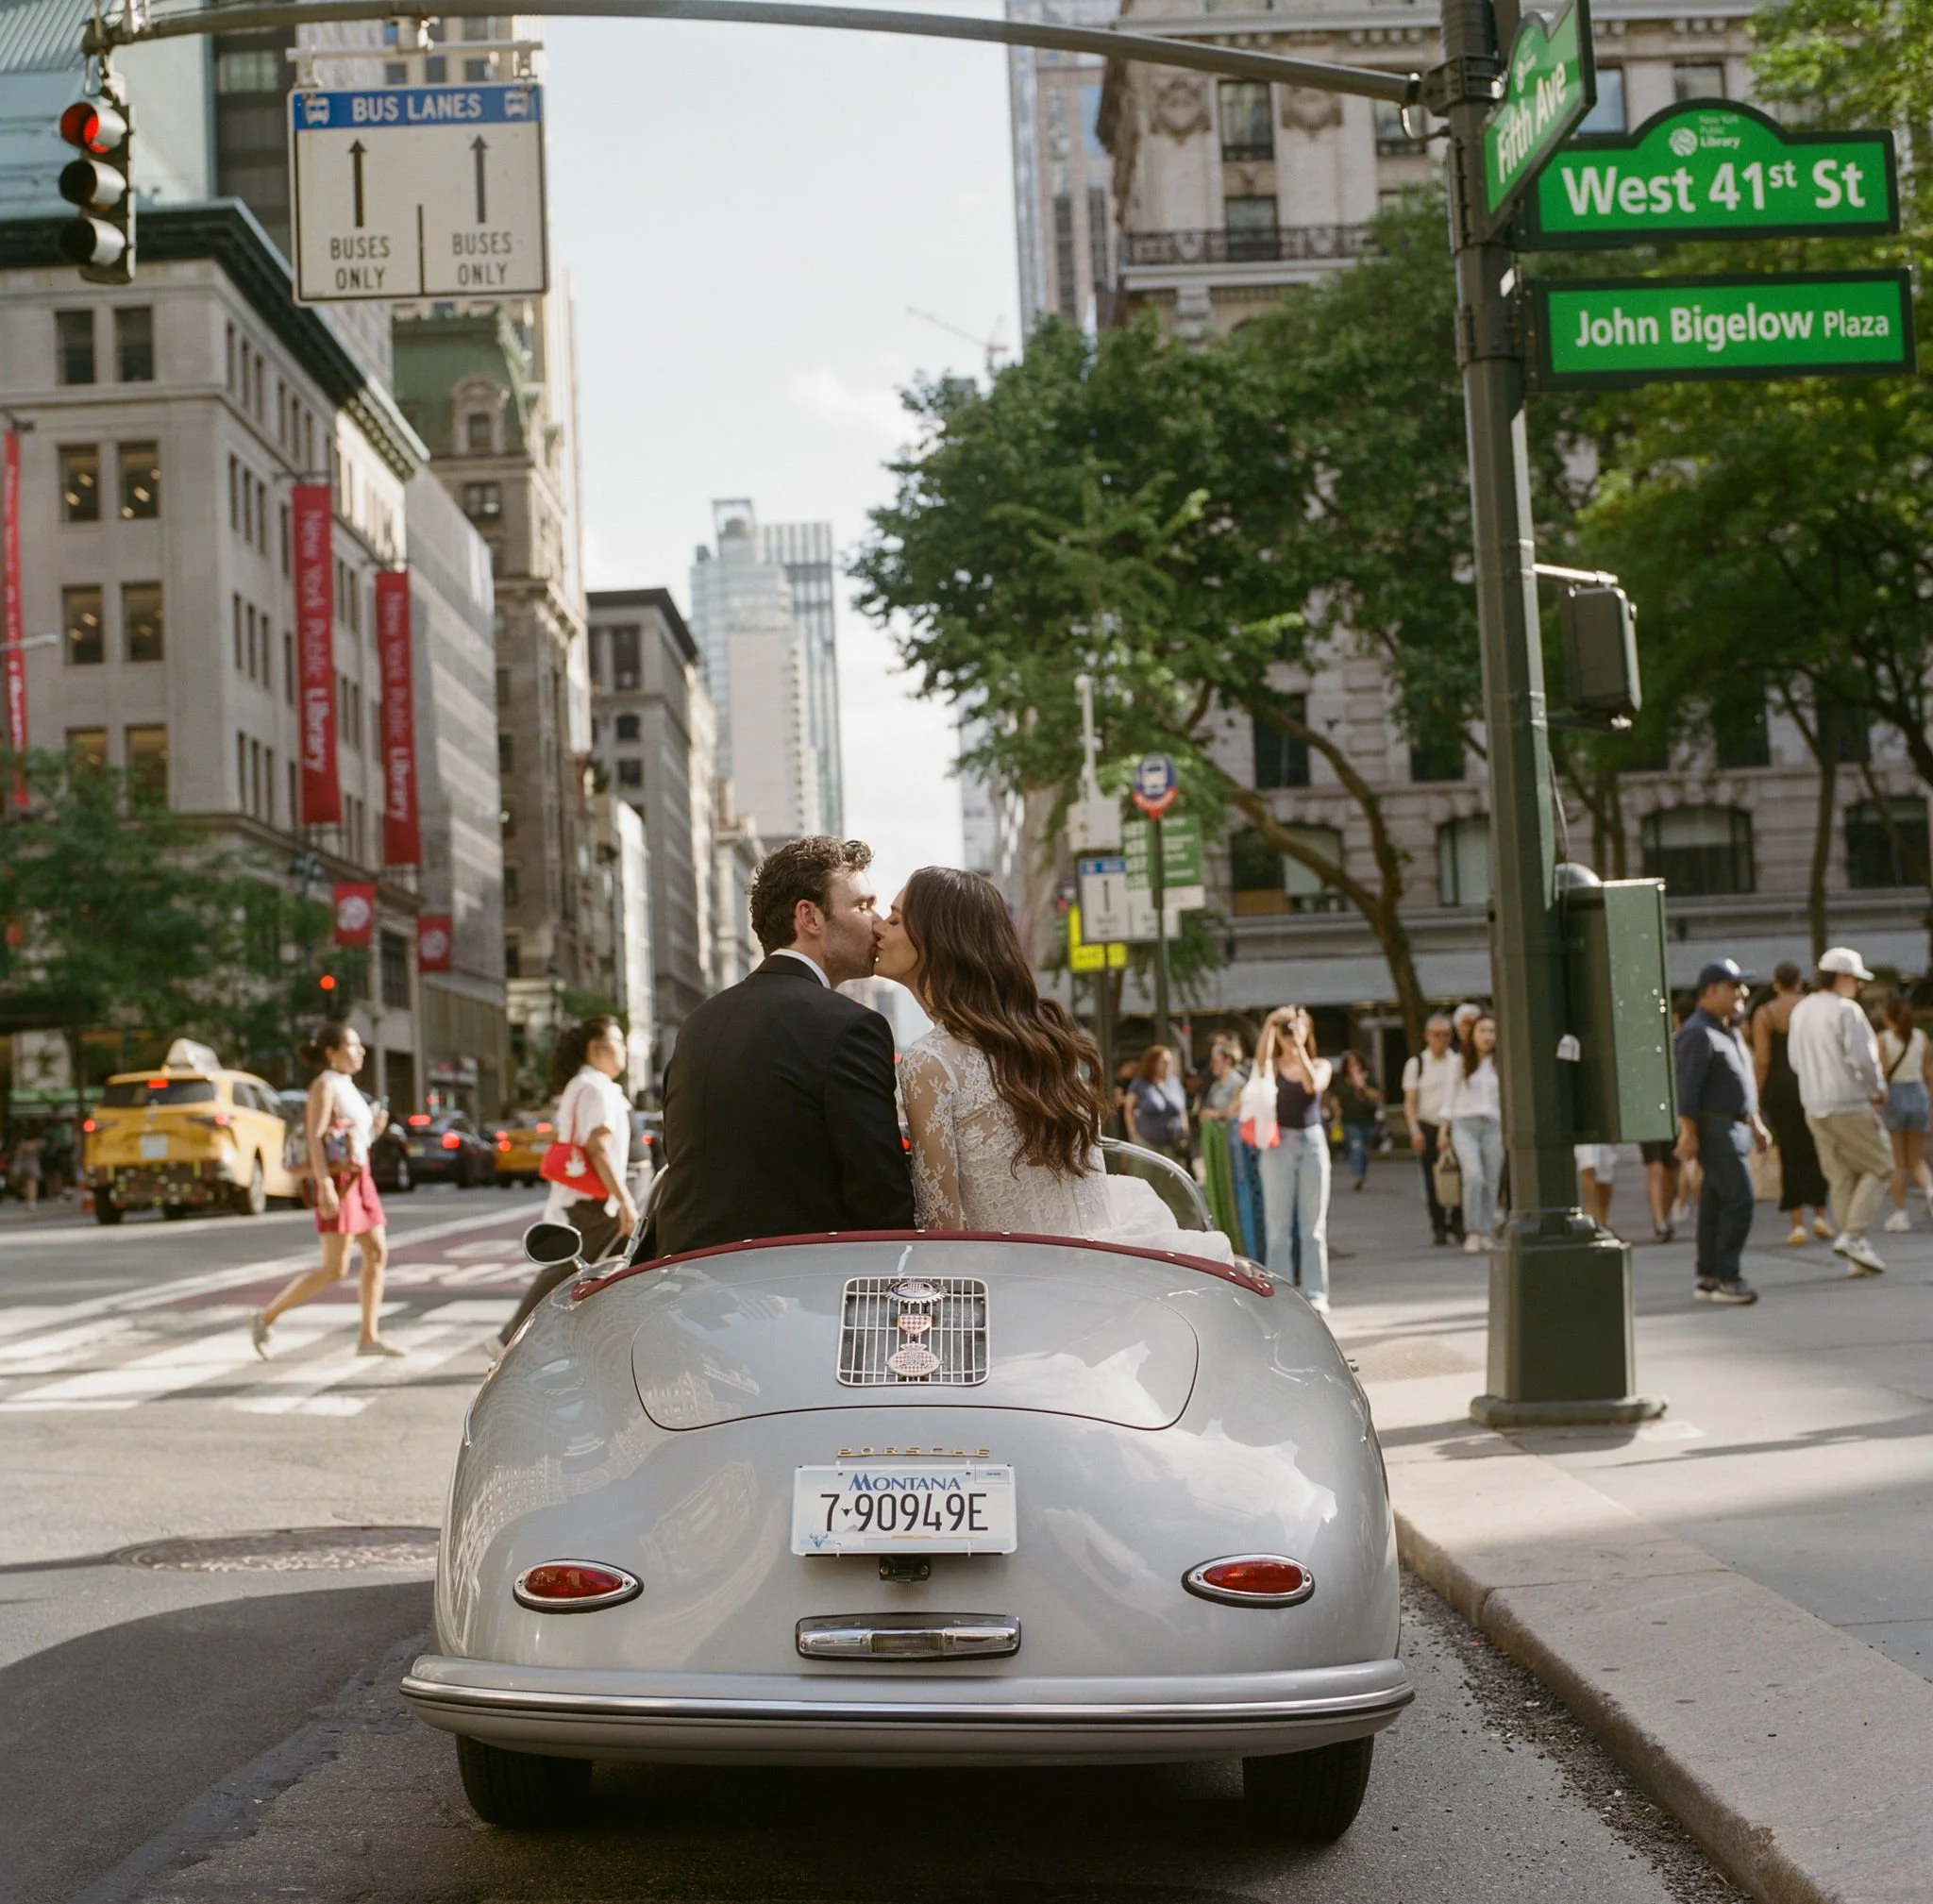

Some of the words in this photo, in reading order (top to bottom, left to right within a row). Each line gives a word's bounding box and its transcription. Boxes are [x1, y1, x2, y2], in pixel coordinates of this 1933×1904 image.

[351, 94, 399, 123] BUS
[407, 93, 483, 120] LANES
[1497, 98, 1533, 183] Fifth
[1536, 61, 1567, 135] Ave
[1700, 136, 1740, 150] Library
[1561, 166, 1696, 216] West
[1708, 160, 1797, 211] 41st
[1812, 159, 1865, 210] St
[330, 235, 391, 261] BUSES
[452, 232, 513, 256] BUSES
[335, 266, 385, 290] ONLY
[458, 261, 508, 285] ONLY
[1575, 307, 1659, 347] John
[1670, 302, 1814, 353] Bigelow
[1823, 309, 1890, 338] Plaza
[304, 687, 330, 774] Library
[388, 747, 411, 823] Library
[837, 1444, 990, 1457] PORSCHE
[849, 1473, 963, 1491] MONTANA
